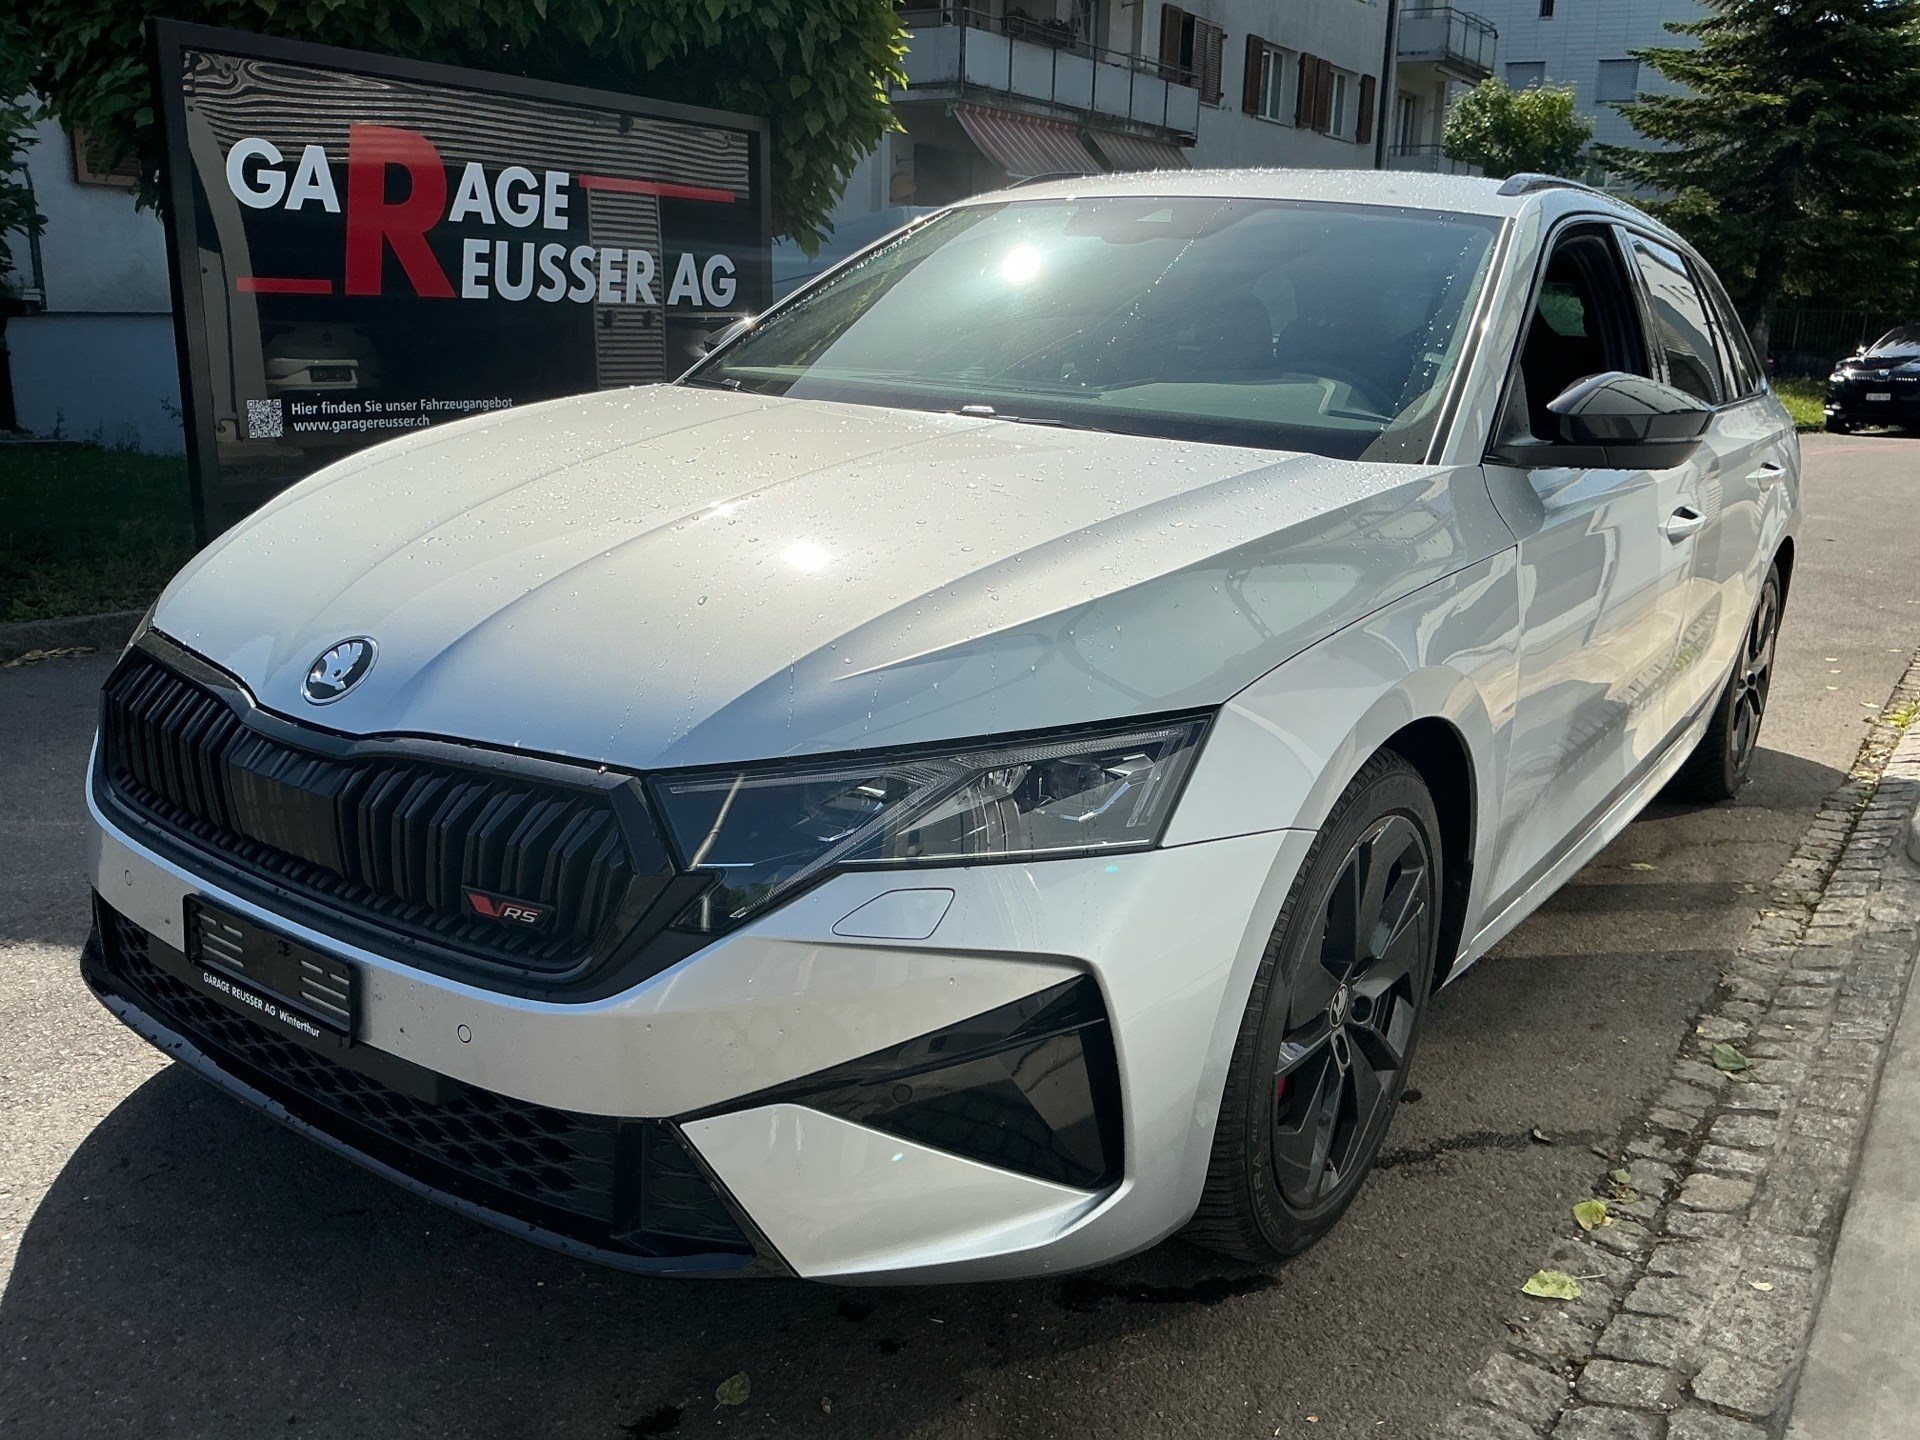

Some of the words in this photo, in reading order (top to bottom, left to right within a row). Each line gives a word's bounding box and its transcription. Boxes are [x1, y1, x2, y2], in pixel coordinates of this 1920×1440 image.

[667, 253, 736, 308] AG
[291, 402, 318, 415] Hier
[321, 401, 361, 414] finden
[364, 400, 382, 412] Sie
[386, 399, 417, 411] unser
[420, 397, 513, 411] Fahrzeugangebot
[293, 414, 430, 433] www.garagereusser.ch
[203, 972, 230, 993] GARAGE
[231, 986, 263, 1010] REUSSER
[264, 1003, 276, 1016] AG
[279, 1009, 320, 1037] Winterthur
